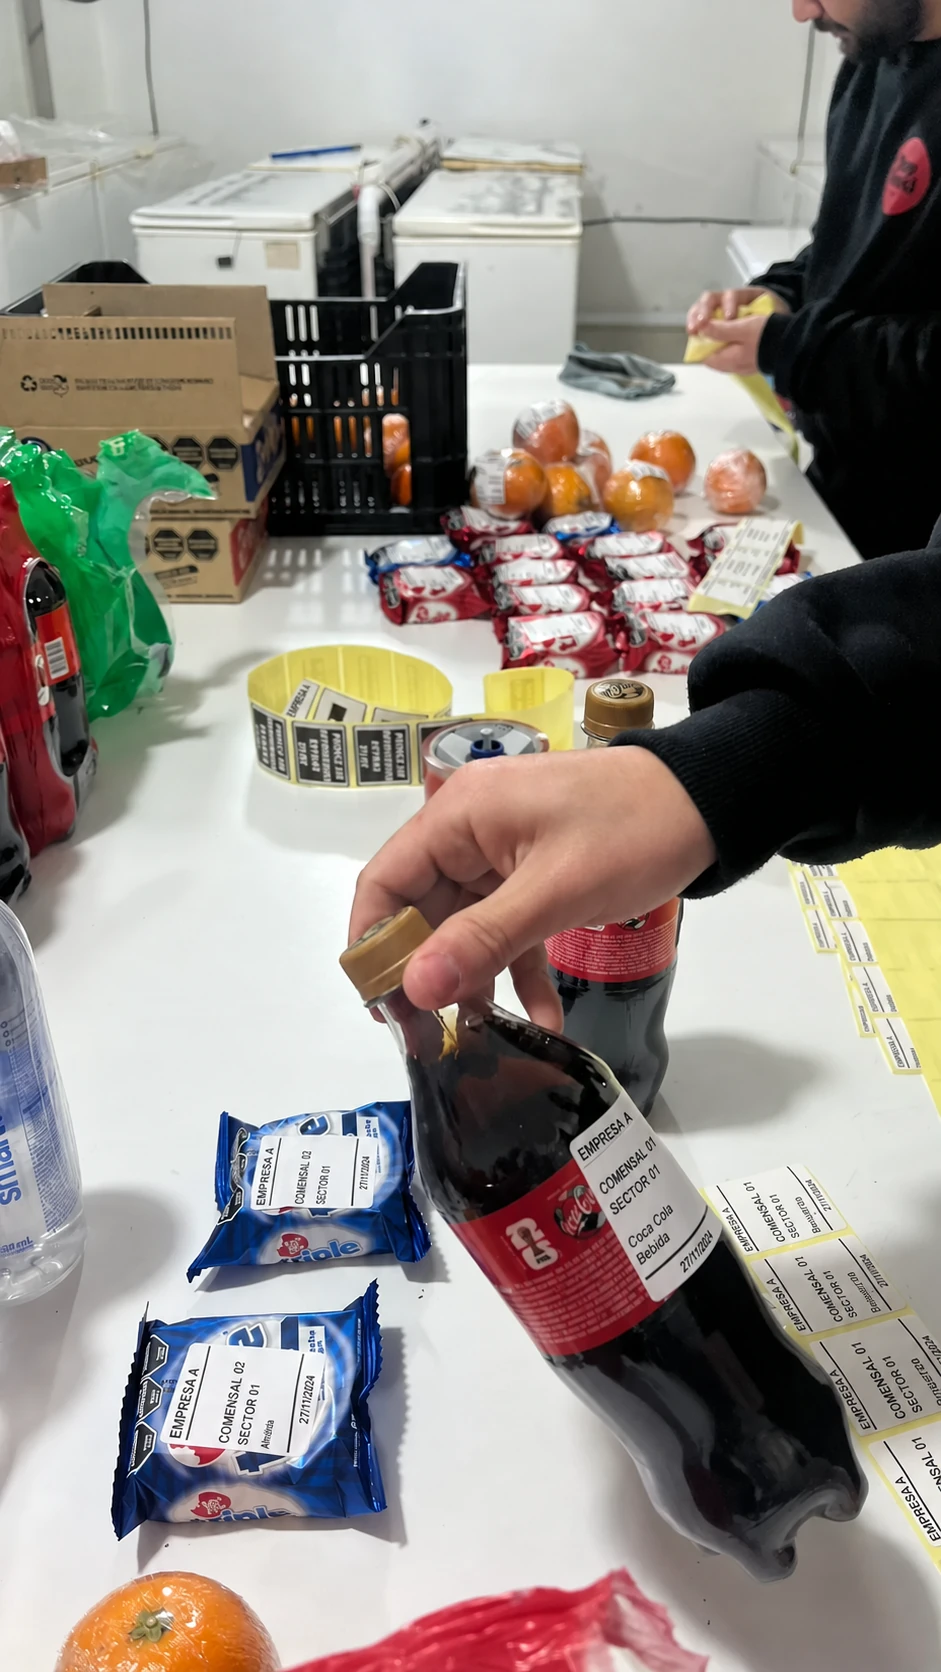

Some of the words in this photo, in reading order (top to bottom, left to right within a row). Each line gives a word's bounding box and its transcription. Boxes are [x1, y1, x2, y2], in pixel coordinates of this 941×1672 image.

[578, 1119, 624, 1161] EMPRESA
[622, 1111, 633, 1124] A
[256, 1155, 273, 1206] EMPRESA
[265, 1147, 274, 1155] A
[294, 1161, 310, 1205] COMENSAL
[302, 1150, 312, 1160] 02
[320, 1165, 331, 1174] 01
[599, 1148, 648, 1195] COMENSAL
[644, 1136, 657, 1152] 01
[743, 1181, 755, 1192] 01
[316, 1174, 330, 1205] SECTOR
[610, 1176, 651, 1216] SECTOR
[648, 1164, 661, 1180] 01
[769, 1194, 781, 1204] 01
[628, 1221, 655, 1249] Coca
[652, 1204, 674, 1228] Cola
[725, 1214, 753, 1252] EMPRESA
[751, 1193, 786, 1243] COMENSAL
[775, 1206, 799, 1239] SECTOR
[637, 1232, 671, 1266] Bebida
[680, 1229, 714, 1273] 27/11/2024
[795, 1257, 808, 1268] 01
[766, 1278, 776, 1286] A
[803, 1269, 843, 1323] COMENSAL
[823, 1270, 836, 1280] 01
[771, 1286, 806, 1332] EMPRESA
[829, 1283, 857, 1319] SECTOR
[851, 1341, 866, 1355] 01
[882, 1355, 896, 1367] 01
[829, 1369, 838, 1377] A
[862, 1356, 906, 1419] COMENSAL
[890, 1369, 923, 1414] SECTOR
[170, 1378, 198, 1440] EMPRESA
[189, 1368, 200, 1376] A
[218, 1377, 242, 1444] COMENSAL
[233, 1361, 246, 1374] 02
[237, 1398, 257, 1446] SECTOR
[249, 1384, 261, 1396] 01
[298, 1374, 316, 1425] 27/11/2024
[834, 1377, 871, 1430] EMPRESA
[911, 1436, 927, 1451] 01
[895, 1475, 904, 1485] A
[901, 1485, 941, 1542] EMPRESA
